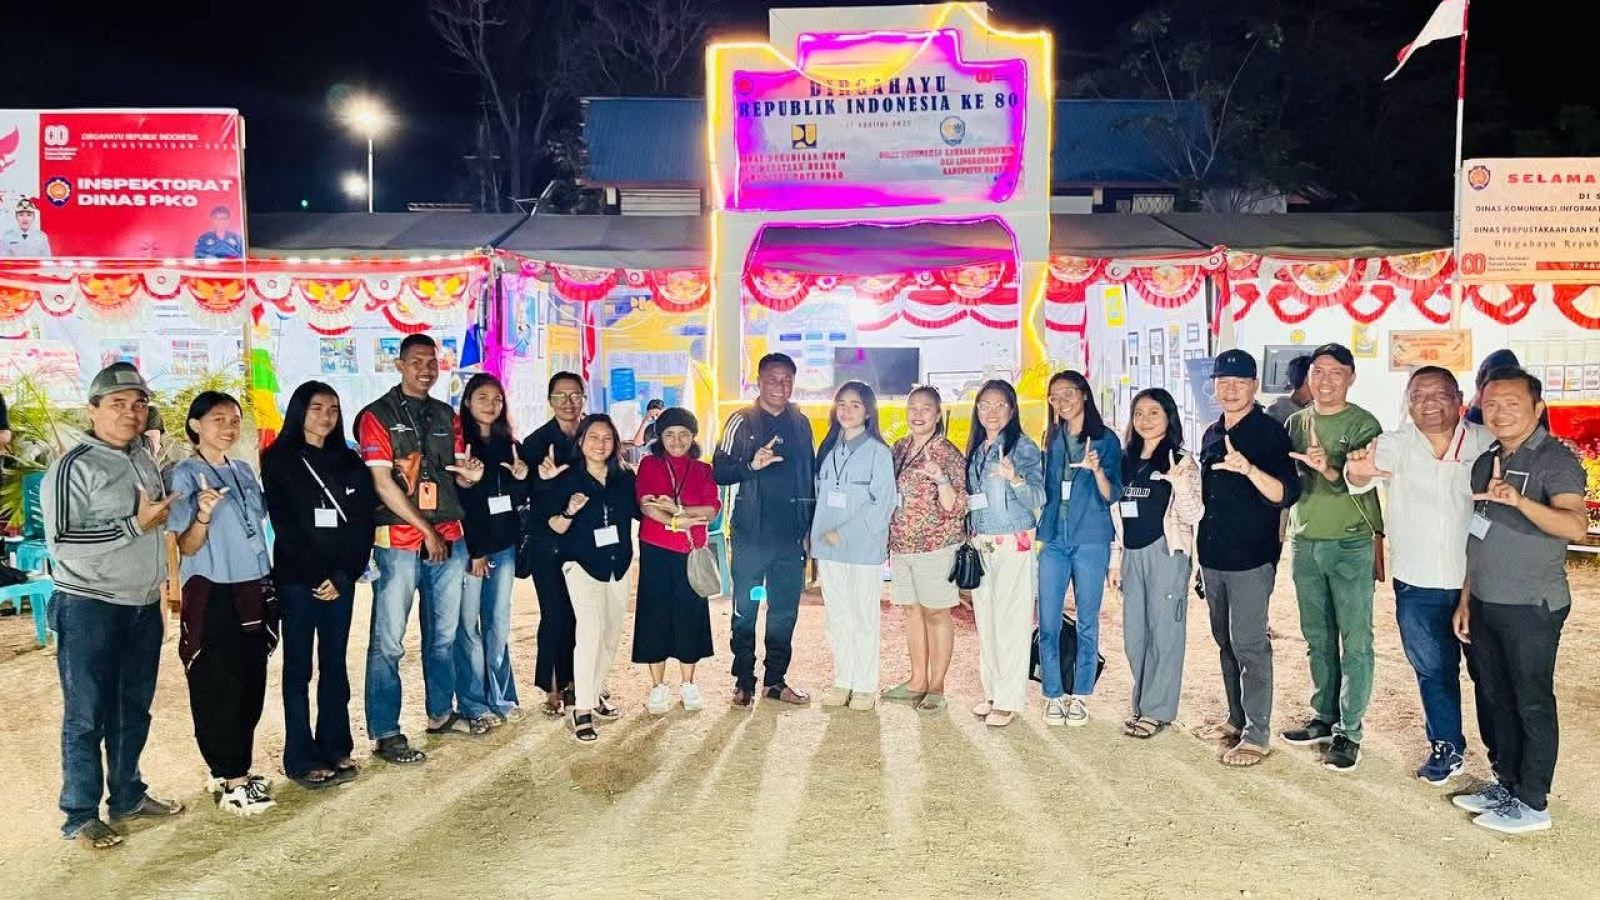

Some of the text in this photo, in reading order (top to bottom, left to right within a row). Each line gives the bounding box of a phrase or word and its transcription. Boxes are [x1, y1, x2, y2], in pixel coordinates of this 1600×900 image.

[809, 76, 946, 96] DIRGAHAYU
[740, 92, 1018, 116] REPUBLIK INDONESIA KE 80
[77, 178, 232, 191] INSPEKTORAT
[77, 194, 198, 206] DINAS PKO
[1494, 240, 1557, 250] Dirgahayu
